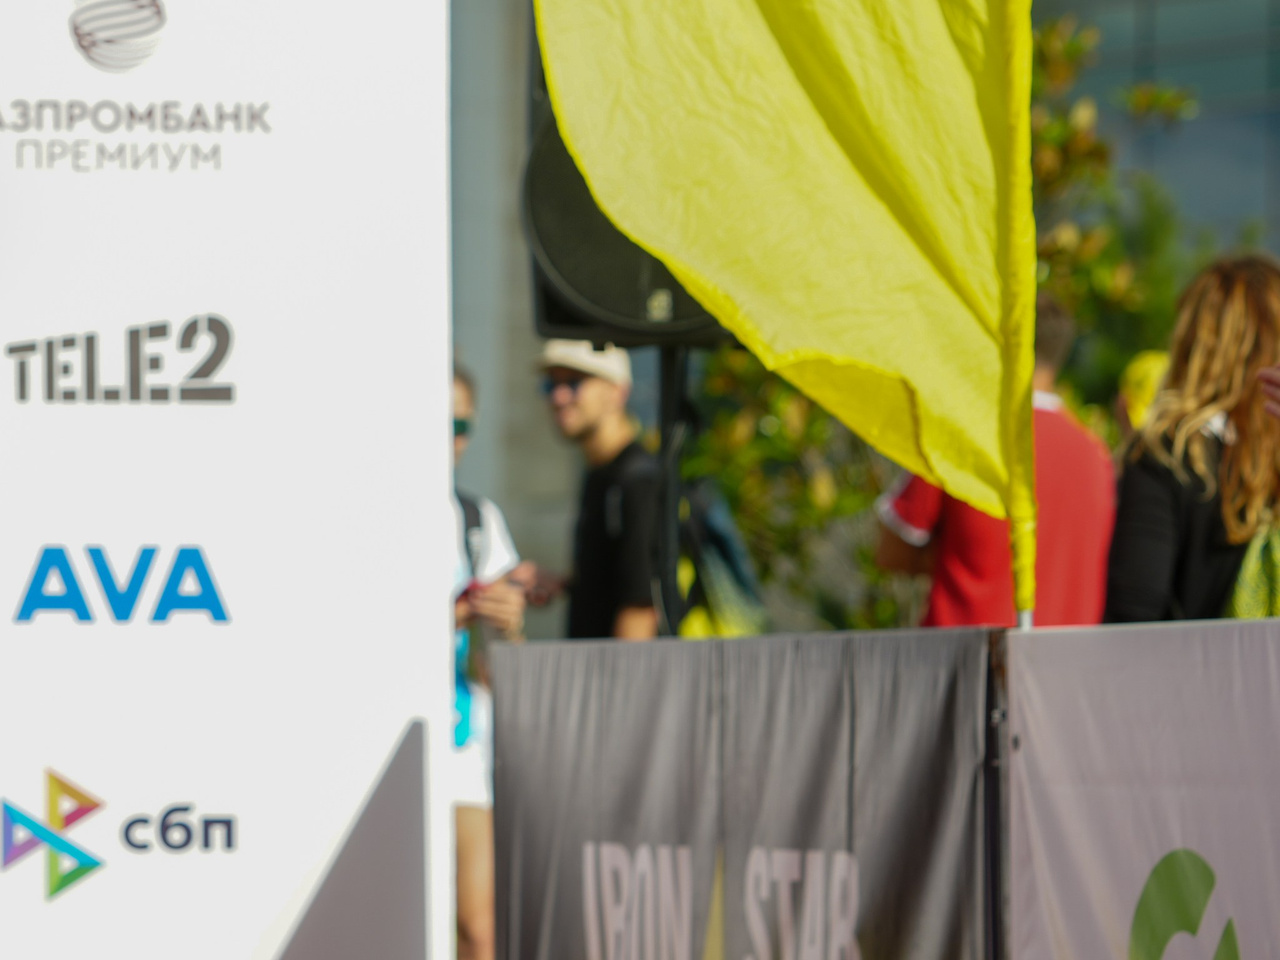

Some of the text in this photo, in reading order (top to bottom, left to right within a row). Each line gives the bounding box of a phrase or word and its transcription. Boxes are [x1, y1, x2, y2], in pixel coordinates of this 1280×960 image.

[15, 138, 222, 173] ПРЕМИУМ
[5, 314, 235, 404] TELE2
[14, 545, 232, 625] AVA
[121, 802, 237, 853] сбп
[581, 842, 692, 960] IRON
